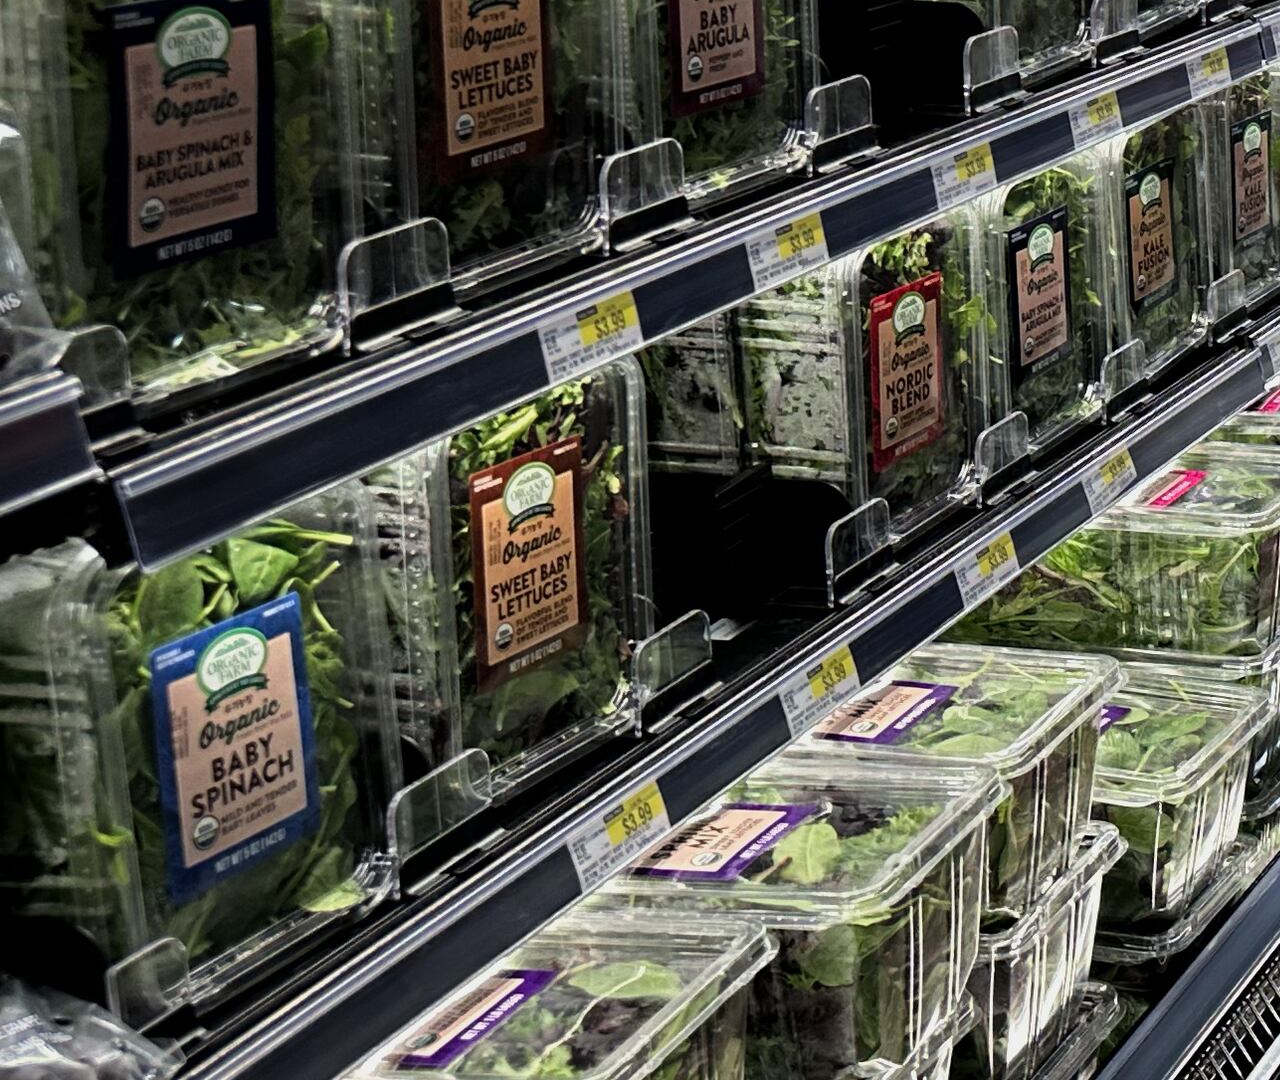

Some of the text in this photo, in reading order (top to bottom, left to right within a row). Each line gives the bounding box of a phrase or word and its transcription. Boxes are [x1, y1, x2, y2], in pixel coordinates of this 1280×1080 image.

[700, 4, 738, 31] BABY
[167, 27, 223, 51] ORGANIC
[176, 40, 214, 64] FARM
[463, 18, 528, 53] Organic
[687, 23, 750, 56] ARUGULA
[450, 50, 539, 91] SWEET BABY
[155, 87, 240, 128] Organic
[458, 72, 533, 110] LETTUCES
[136, 129, 254, 173] BABY SPINACH &
[471, 153, 483, 169] NET
[145, 150, 245, 191] ARUGULA MIX
[157, 242, 175, 262] NET
[176, 239, 187, 258] WT
[791, 228, 816, 254] $3.99
[1143, 232, 1165, 258] KALE
[1138, 244, 1170, 273] FUSION
[595, 311, 627, 340] $3.99
[891, 341, 930, 372] Organic
[886, 361, 934, 401] NORDIC
[891, 383, 931, 417] BLEND
[510, 476, 551, 503] ORGANIC
[518, 491, 545, 510] FARM
[503, 524, 563, 566] Organic
[491, 550, 573, 604] SWEET BABY
[497, 573, 569, 621] LETTUCES
[516, 594, 575, 627] FLAVORFUL BLEND
[516, 606, 569, 637] OF TENDER AND
[516, 614, 570, 647] SWEET LETTUCES
[206, 642, 260, 678] ORGANIC
[216, 660, 251, 685] FARM
[509, 658, 522, 674] NET
[820, 662, 848, 691] $3.99
[199, 696, 281, 749] Organic
[211, 732, 275, 784] BABY
[191, 749, 295, 820] SPINACH
[220, 779, 299, 825] MILD AND TENDER
[220, 801, 277, 837] BABY LEAVES
[621, 802, 654, 838] $3.99
[214, 855, 232, 874] NET
[231, 850, 244, 869] WT
[262, 826, 287, 855] (142G)
[687, 823, 729, 850] MIX
